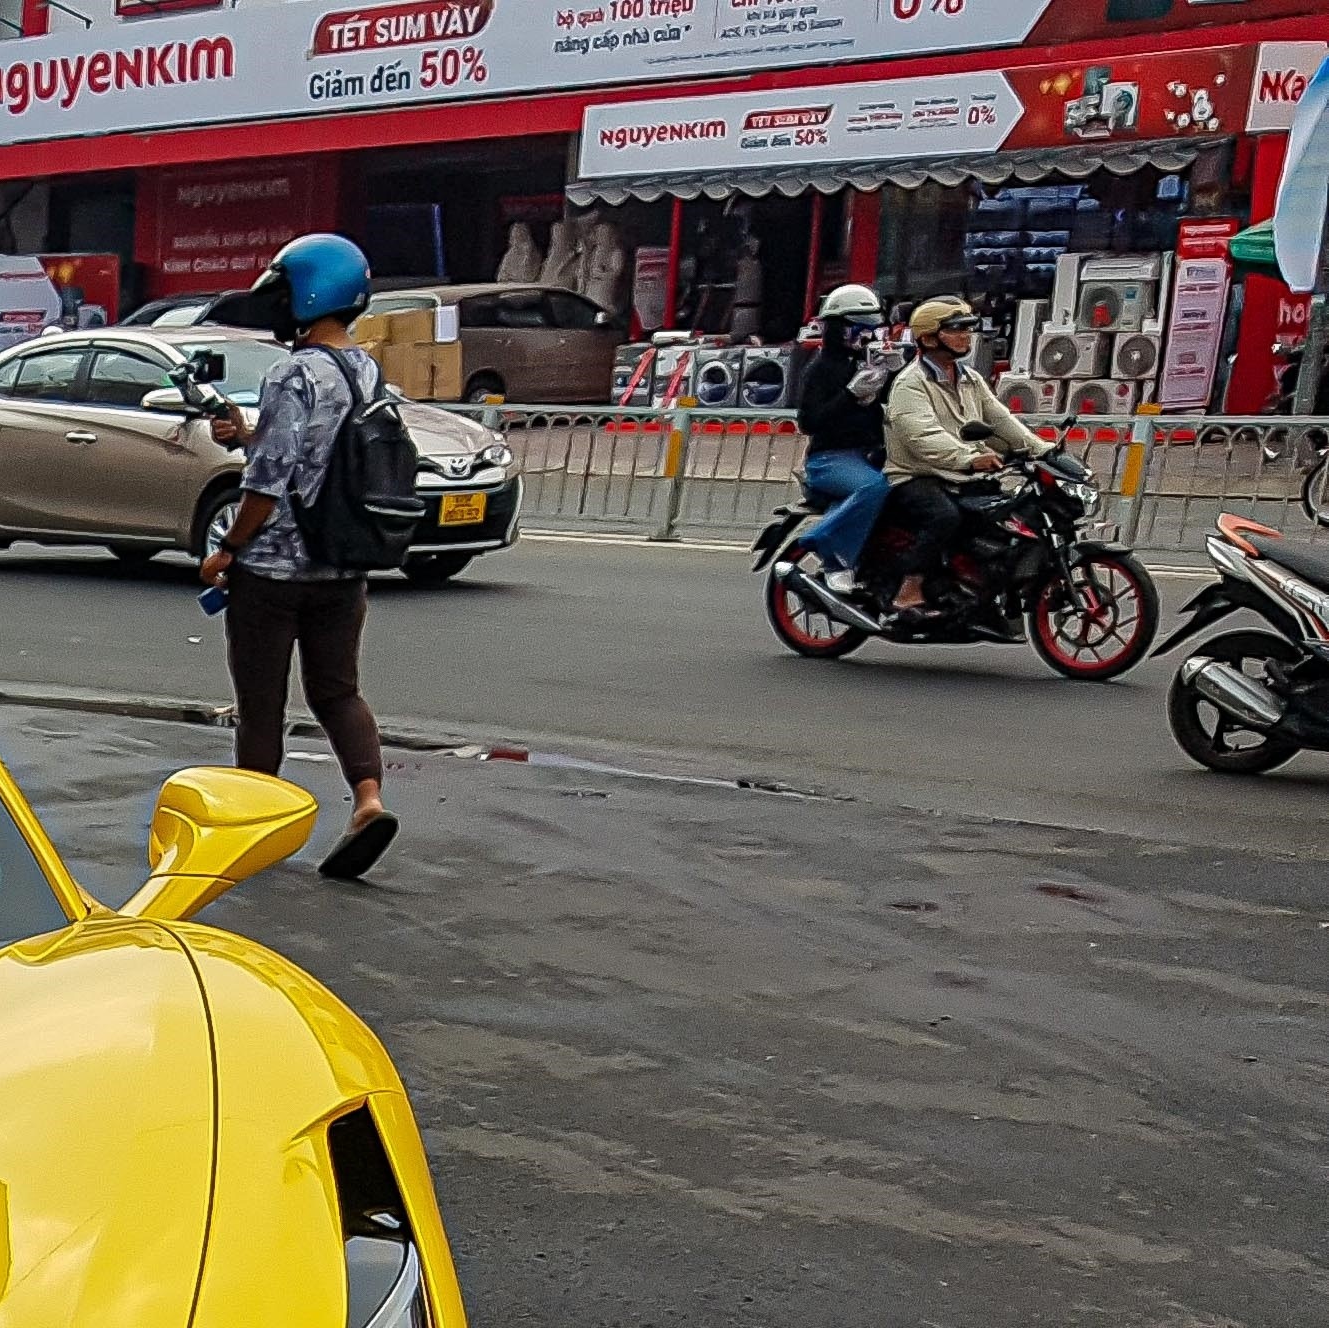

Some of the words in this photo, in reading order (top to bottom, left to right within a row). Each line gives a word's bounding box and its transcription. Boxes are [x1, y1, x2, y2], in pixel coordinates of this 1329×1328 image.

[374, 13, 426, 43] SUM
[309, 68, 364, 99] Giảm
[370, 60, 411, 92] đến
[419, 47, 488, 88] 50%
[968, 104, 996, 125] 0%
[794, 128, 828, 146] 50%
